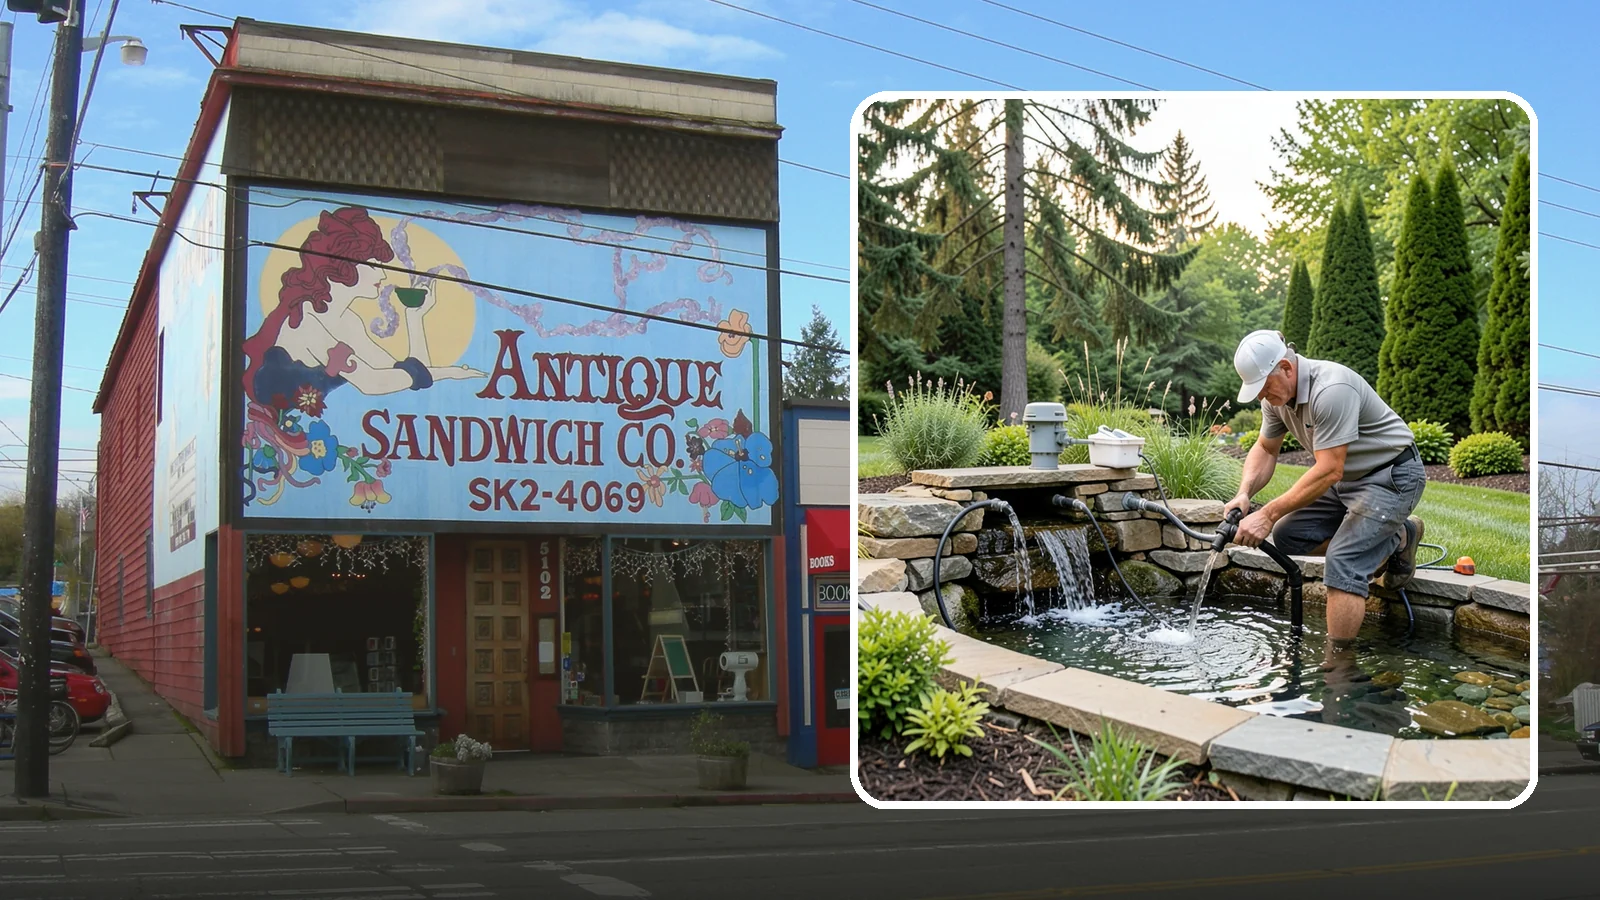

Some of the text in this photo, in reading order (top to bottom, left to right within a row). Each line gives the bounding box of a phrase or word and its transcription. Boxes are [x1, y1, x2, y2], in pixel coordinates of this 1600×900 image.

[476, 329, 723, 421] ANTIQUE
[361, 408, 685, 469] SANDWICH CO.
[468, 477, 645, 513] SK2-4069
[540, 541, 552, 600] 5102
[809, 555, 835, 569] BOOKS
